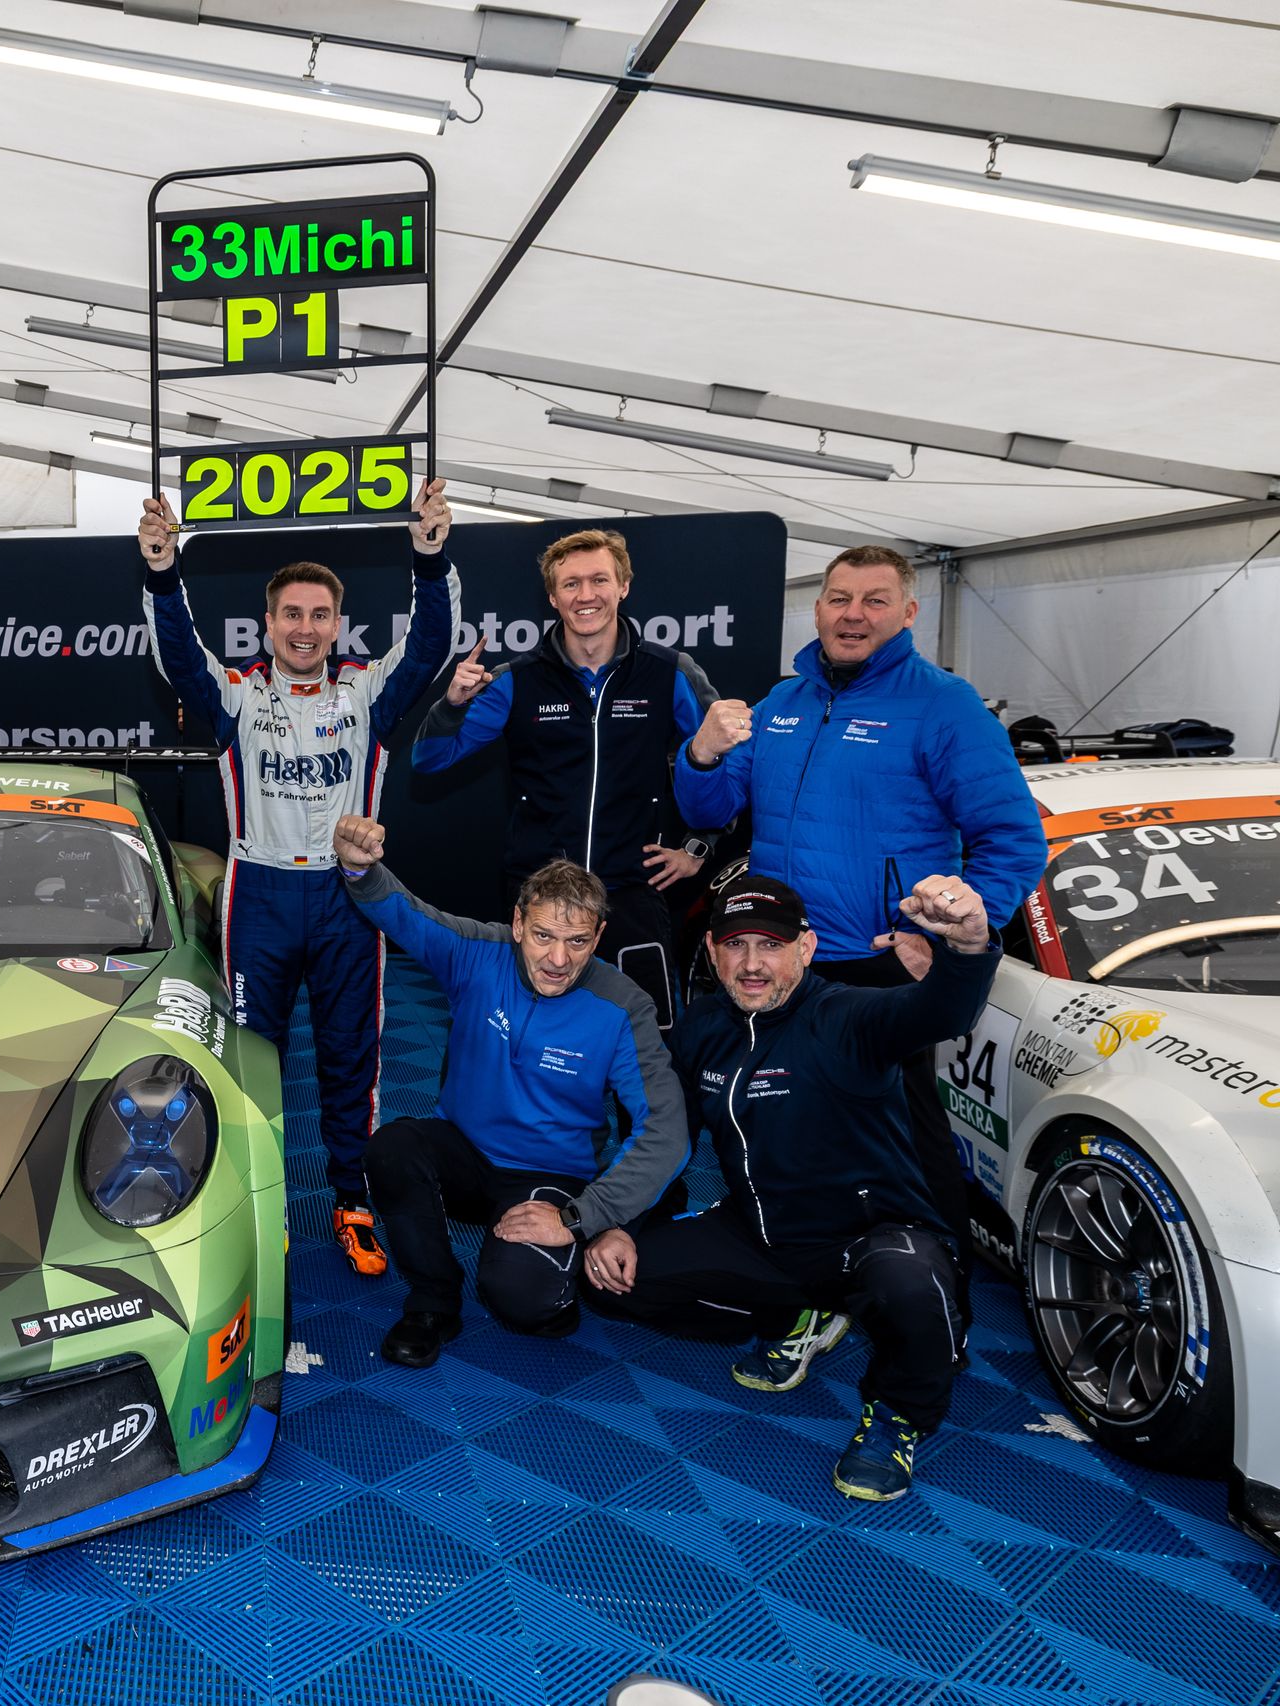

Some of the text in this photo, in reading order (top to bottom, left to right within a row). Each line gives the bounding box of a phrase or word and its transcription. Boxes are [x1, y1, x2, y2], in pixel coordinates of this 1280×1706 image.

[227, 292, 326, 362] P1
[185, 446, 409, 520] 2025
[224, 616, 371, 657] Bk
[539, 704, 570, 713] HAKRO
[260, 749, 324, 789] H&R
[260, 788, 327, 802] Das Fahrwerk!
[57, 850, 91, 862] Sabelt
[1073, 819, 1280, 859] T. Oeve
[1053, 852, 1219, 922] 34
[1027, 890, 1055, 945] he.de/pccd
[235, 971, 247, 1008] Bonk
[210, 1040, 224, 1059] Das
[1014, 1047, 1064, 1090] CHEMIE
[1022, 1029, 1078, 1068] MONTAN
[948, 1032, 998, 1107] 34
[759, 1089, 791, 1097] Motorsport
[948, 1088, 997, 1140] DEKRA
[189, 1351, 252, 1439] Mobil 1
[26, 1413, 141, 1480] DREXLER
[23, 1457, 95, 1493] AUTOMOTIVE
